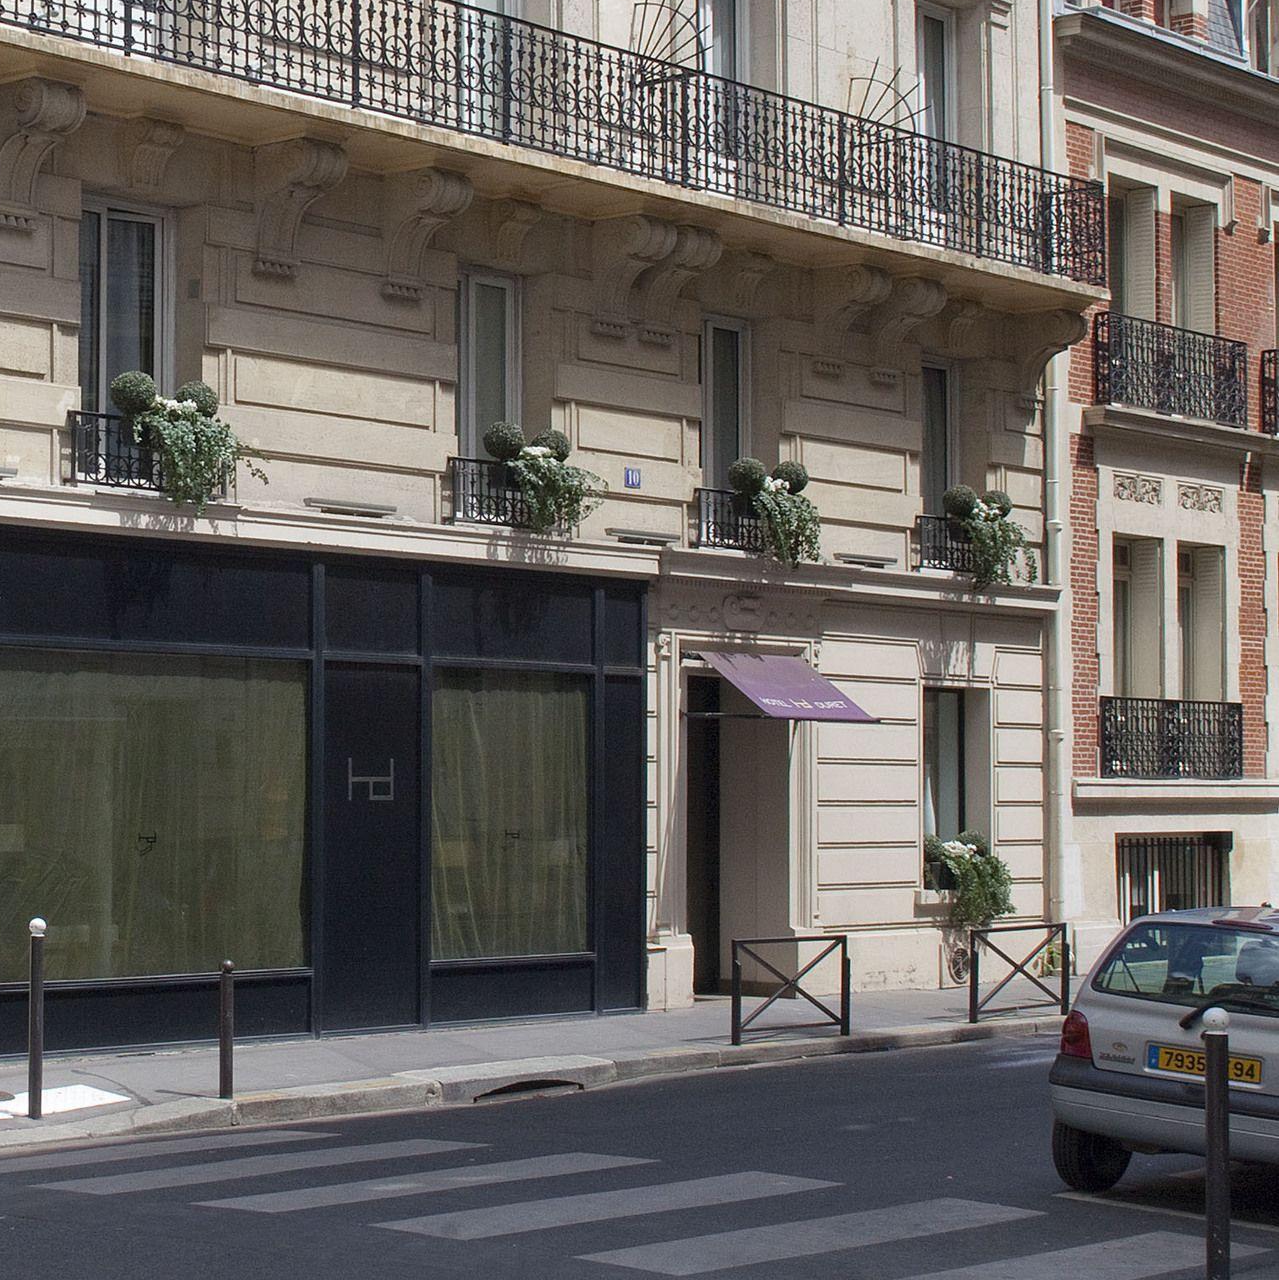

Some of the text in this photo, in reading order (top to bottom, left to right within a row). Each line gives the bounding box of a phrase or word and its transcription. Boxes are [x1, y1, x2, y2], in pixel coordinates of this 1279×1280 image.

[628, 470, 639, 485] 10
[759, 696, 792, 708] HOTEL
[813, 700, 847, 709] DURET
[1164, 1051, 1255, 1079] 7935 94
